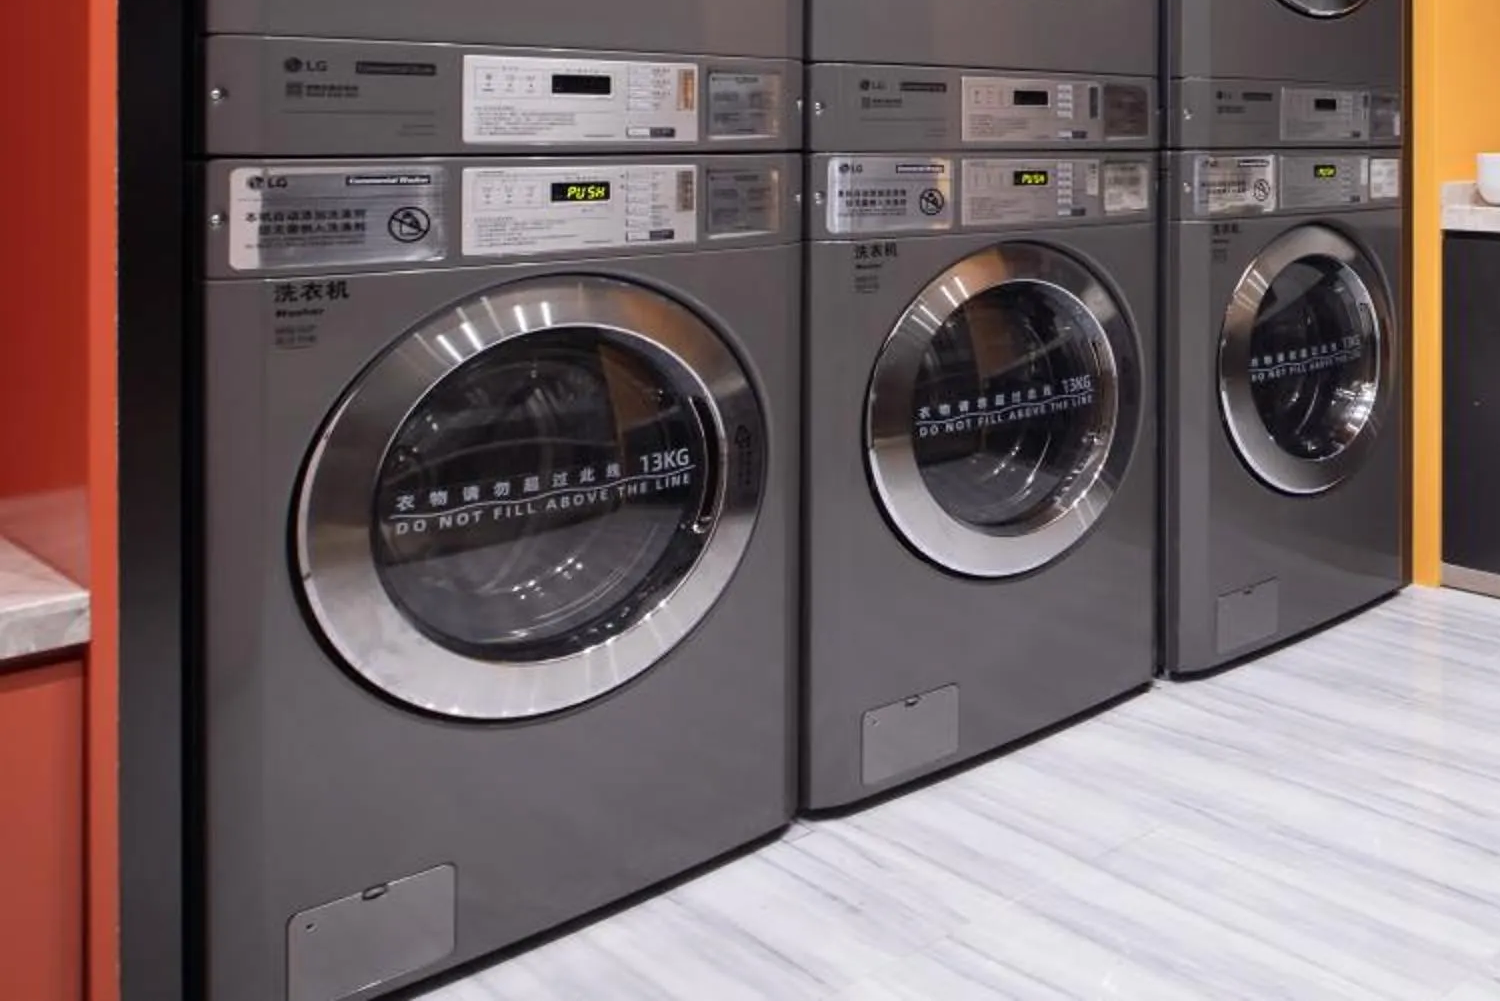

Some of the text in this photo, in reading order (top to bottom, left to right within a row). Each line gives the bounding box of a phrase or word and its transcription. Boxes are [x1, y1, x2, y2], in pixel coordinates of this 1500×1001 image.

[566, 185, 606, 200] PUSH
[274, 281, 350, 303] 洗衣机
[1061, 374, 1091, 394] 13KG
[919, 425, 939, 437] DO
[945, 419, 972, 433] NOT
[977, 413, 1004, 427] FILL
[639, 448, 689, 474] 13KG
[396, 473, 690, 535] DO NOT FILL ABOVE THE LINE
